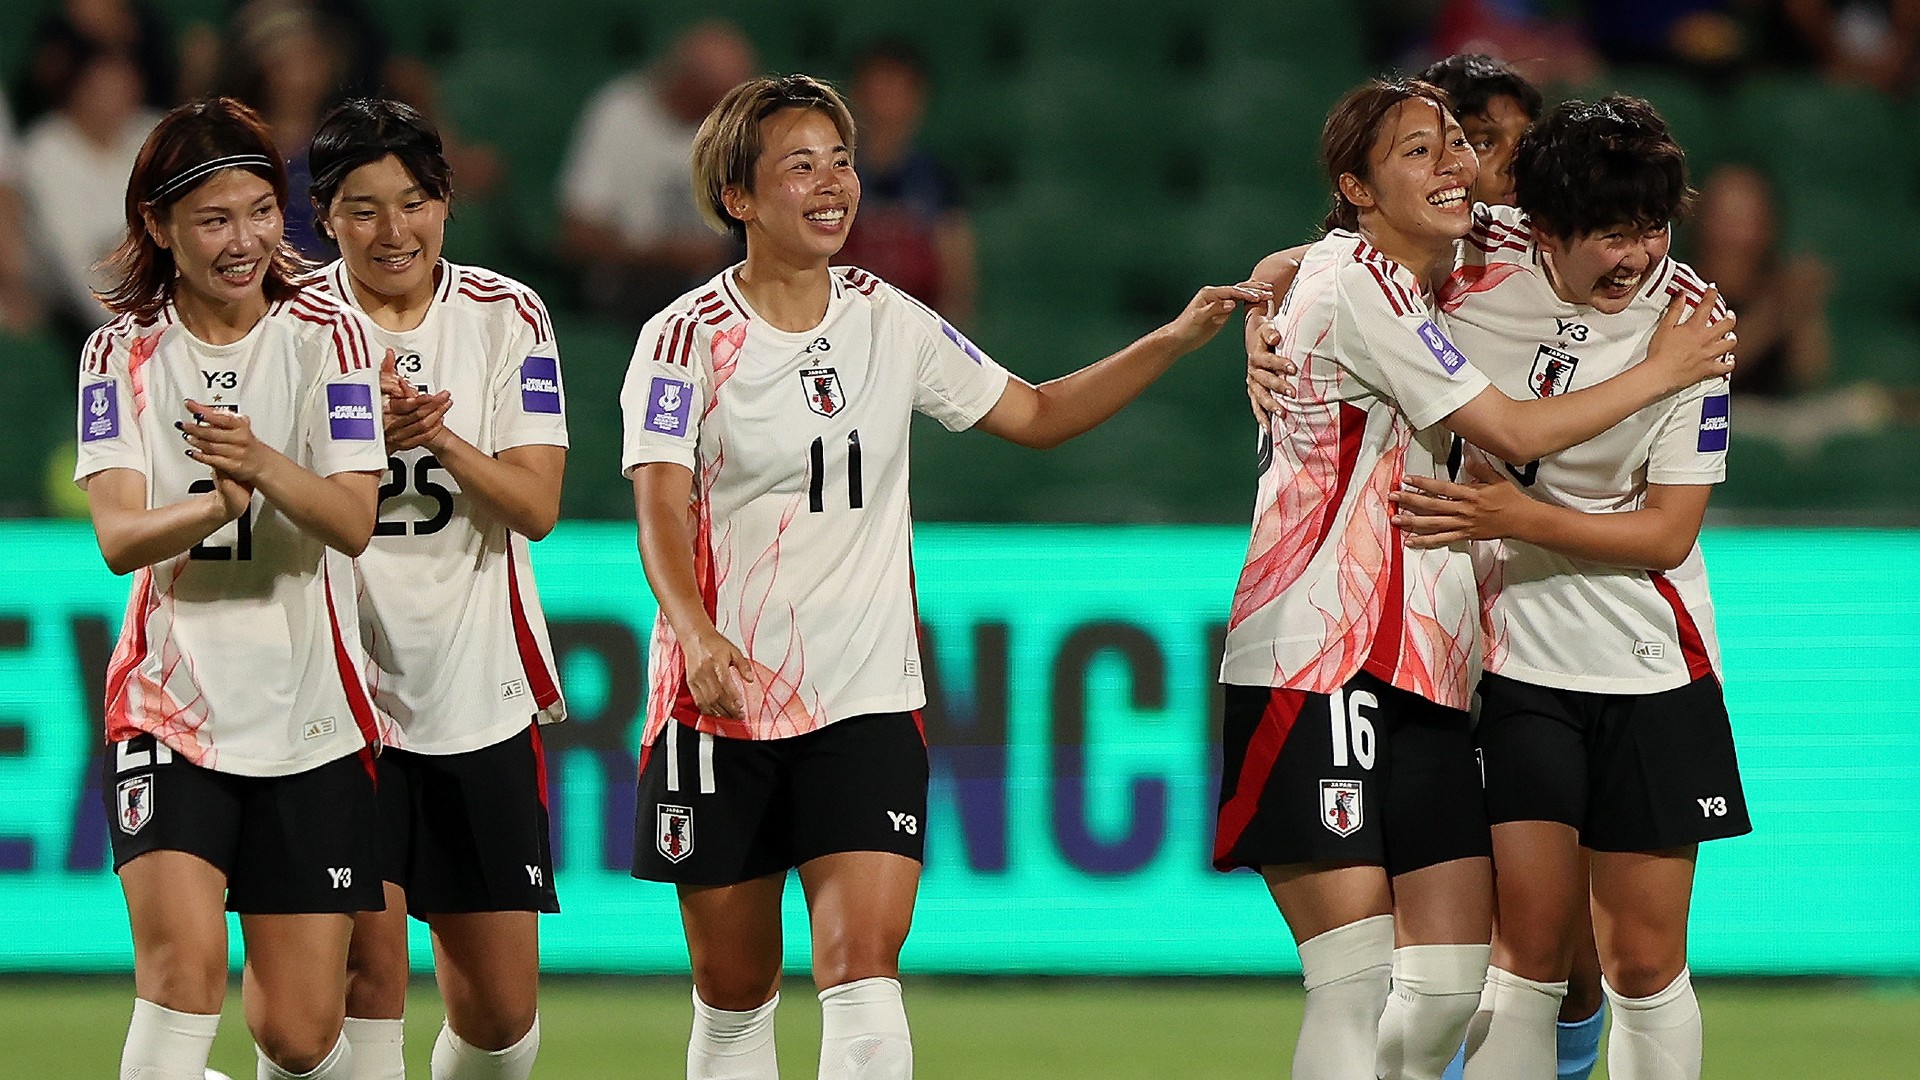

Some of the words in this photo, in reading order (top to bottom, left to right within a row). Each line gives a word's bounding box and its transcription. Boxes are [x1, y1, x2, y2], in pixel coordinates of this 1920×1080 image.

[1555, 317, 1589, 341] Y-3
[1548, 349, 1570, 361] JAPAN
[201, 370, 237, 389] Y-3
[809, 428, 863, 513] 11
[373, 455, 453, 536] 25
[1329, 687, 1378, 770] 16
[666, 716, 716, 794] 11
[1696, 796, 1728, 818] Y-3
[886, 810, 917, 835] Y-3
[327, 867, 352, 889] Y-3
